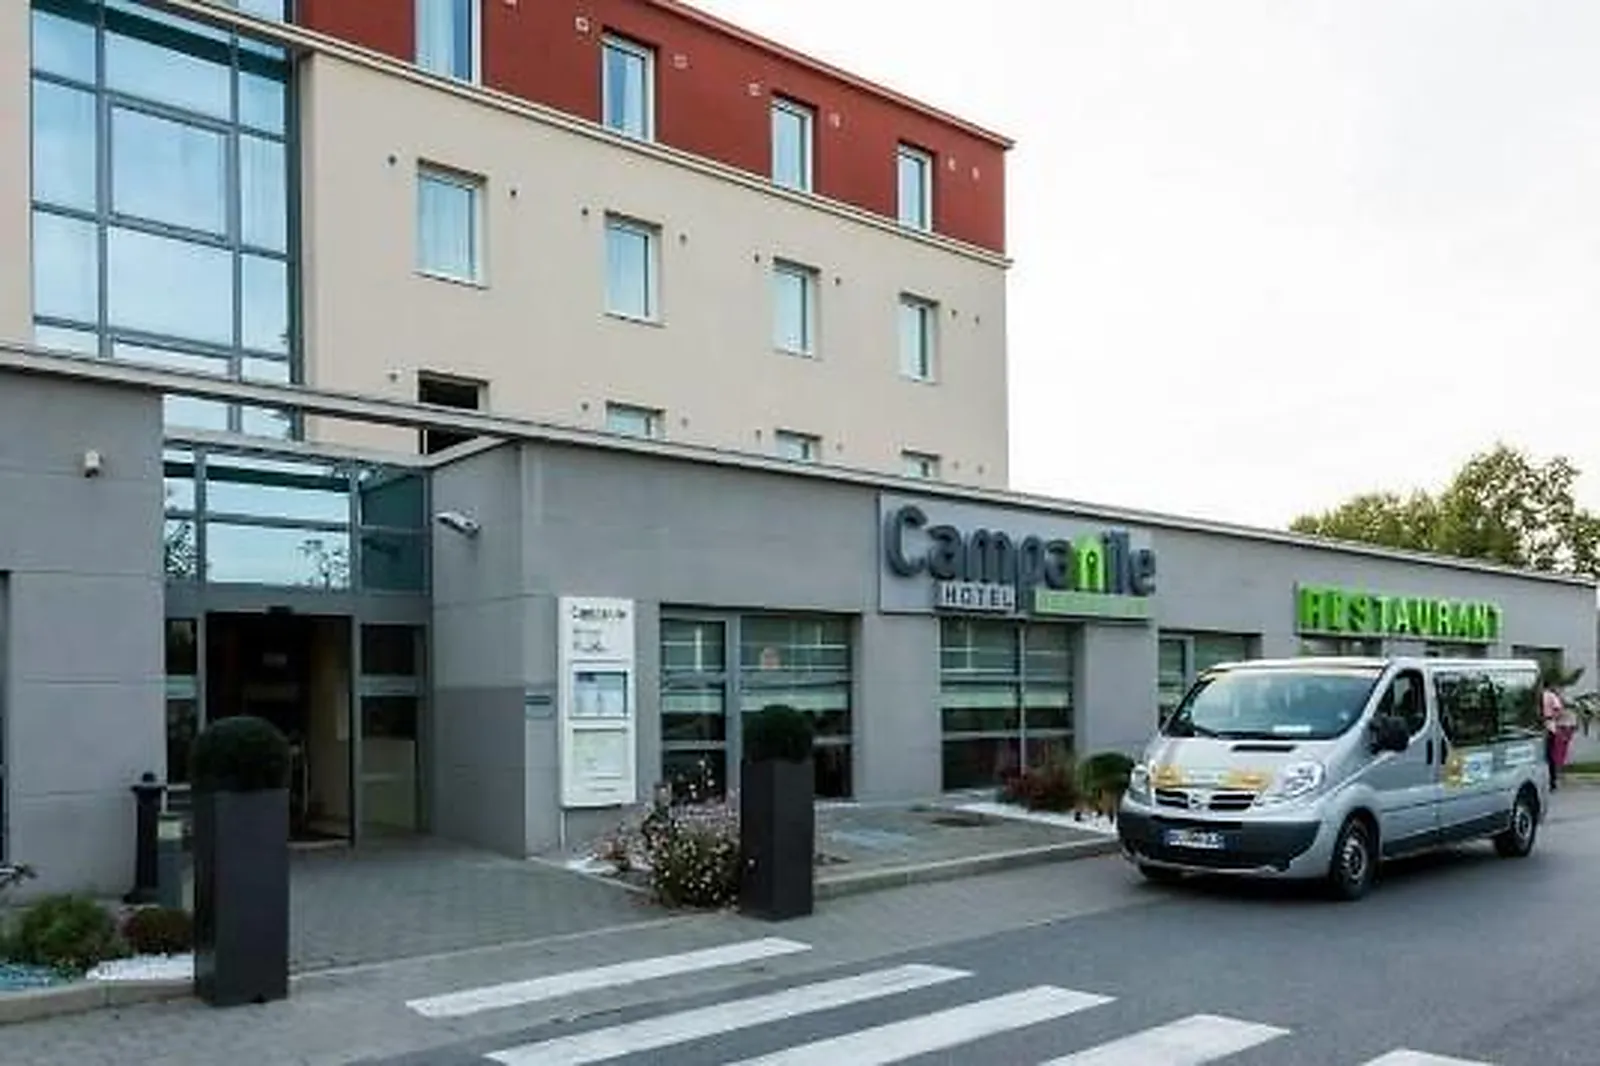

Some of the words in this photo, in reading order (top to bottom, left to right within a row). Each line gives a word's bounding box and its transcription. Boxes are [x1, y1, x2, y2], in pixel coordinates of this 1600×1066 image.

[884, 504, 1157, 611] Campanile
[943, 585, 1013, 607] HOTEL
[1297, 584, 1503, 642] RESTAURANT
